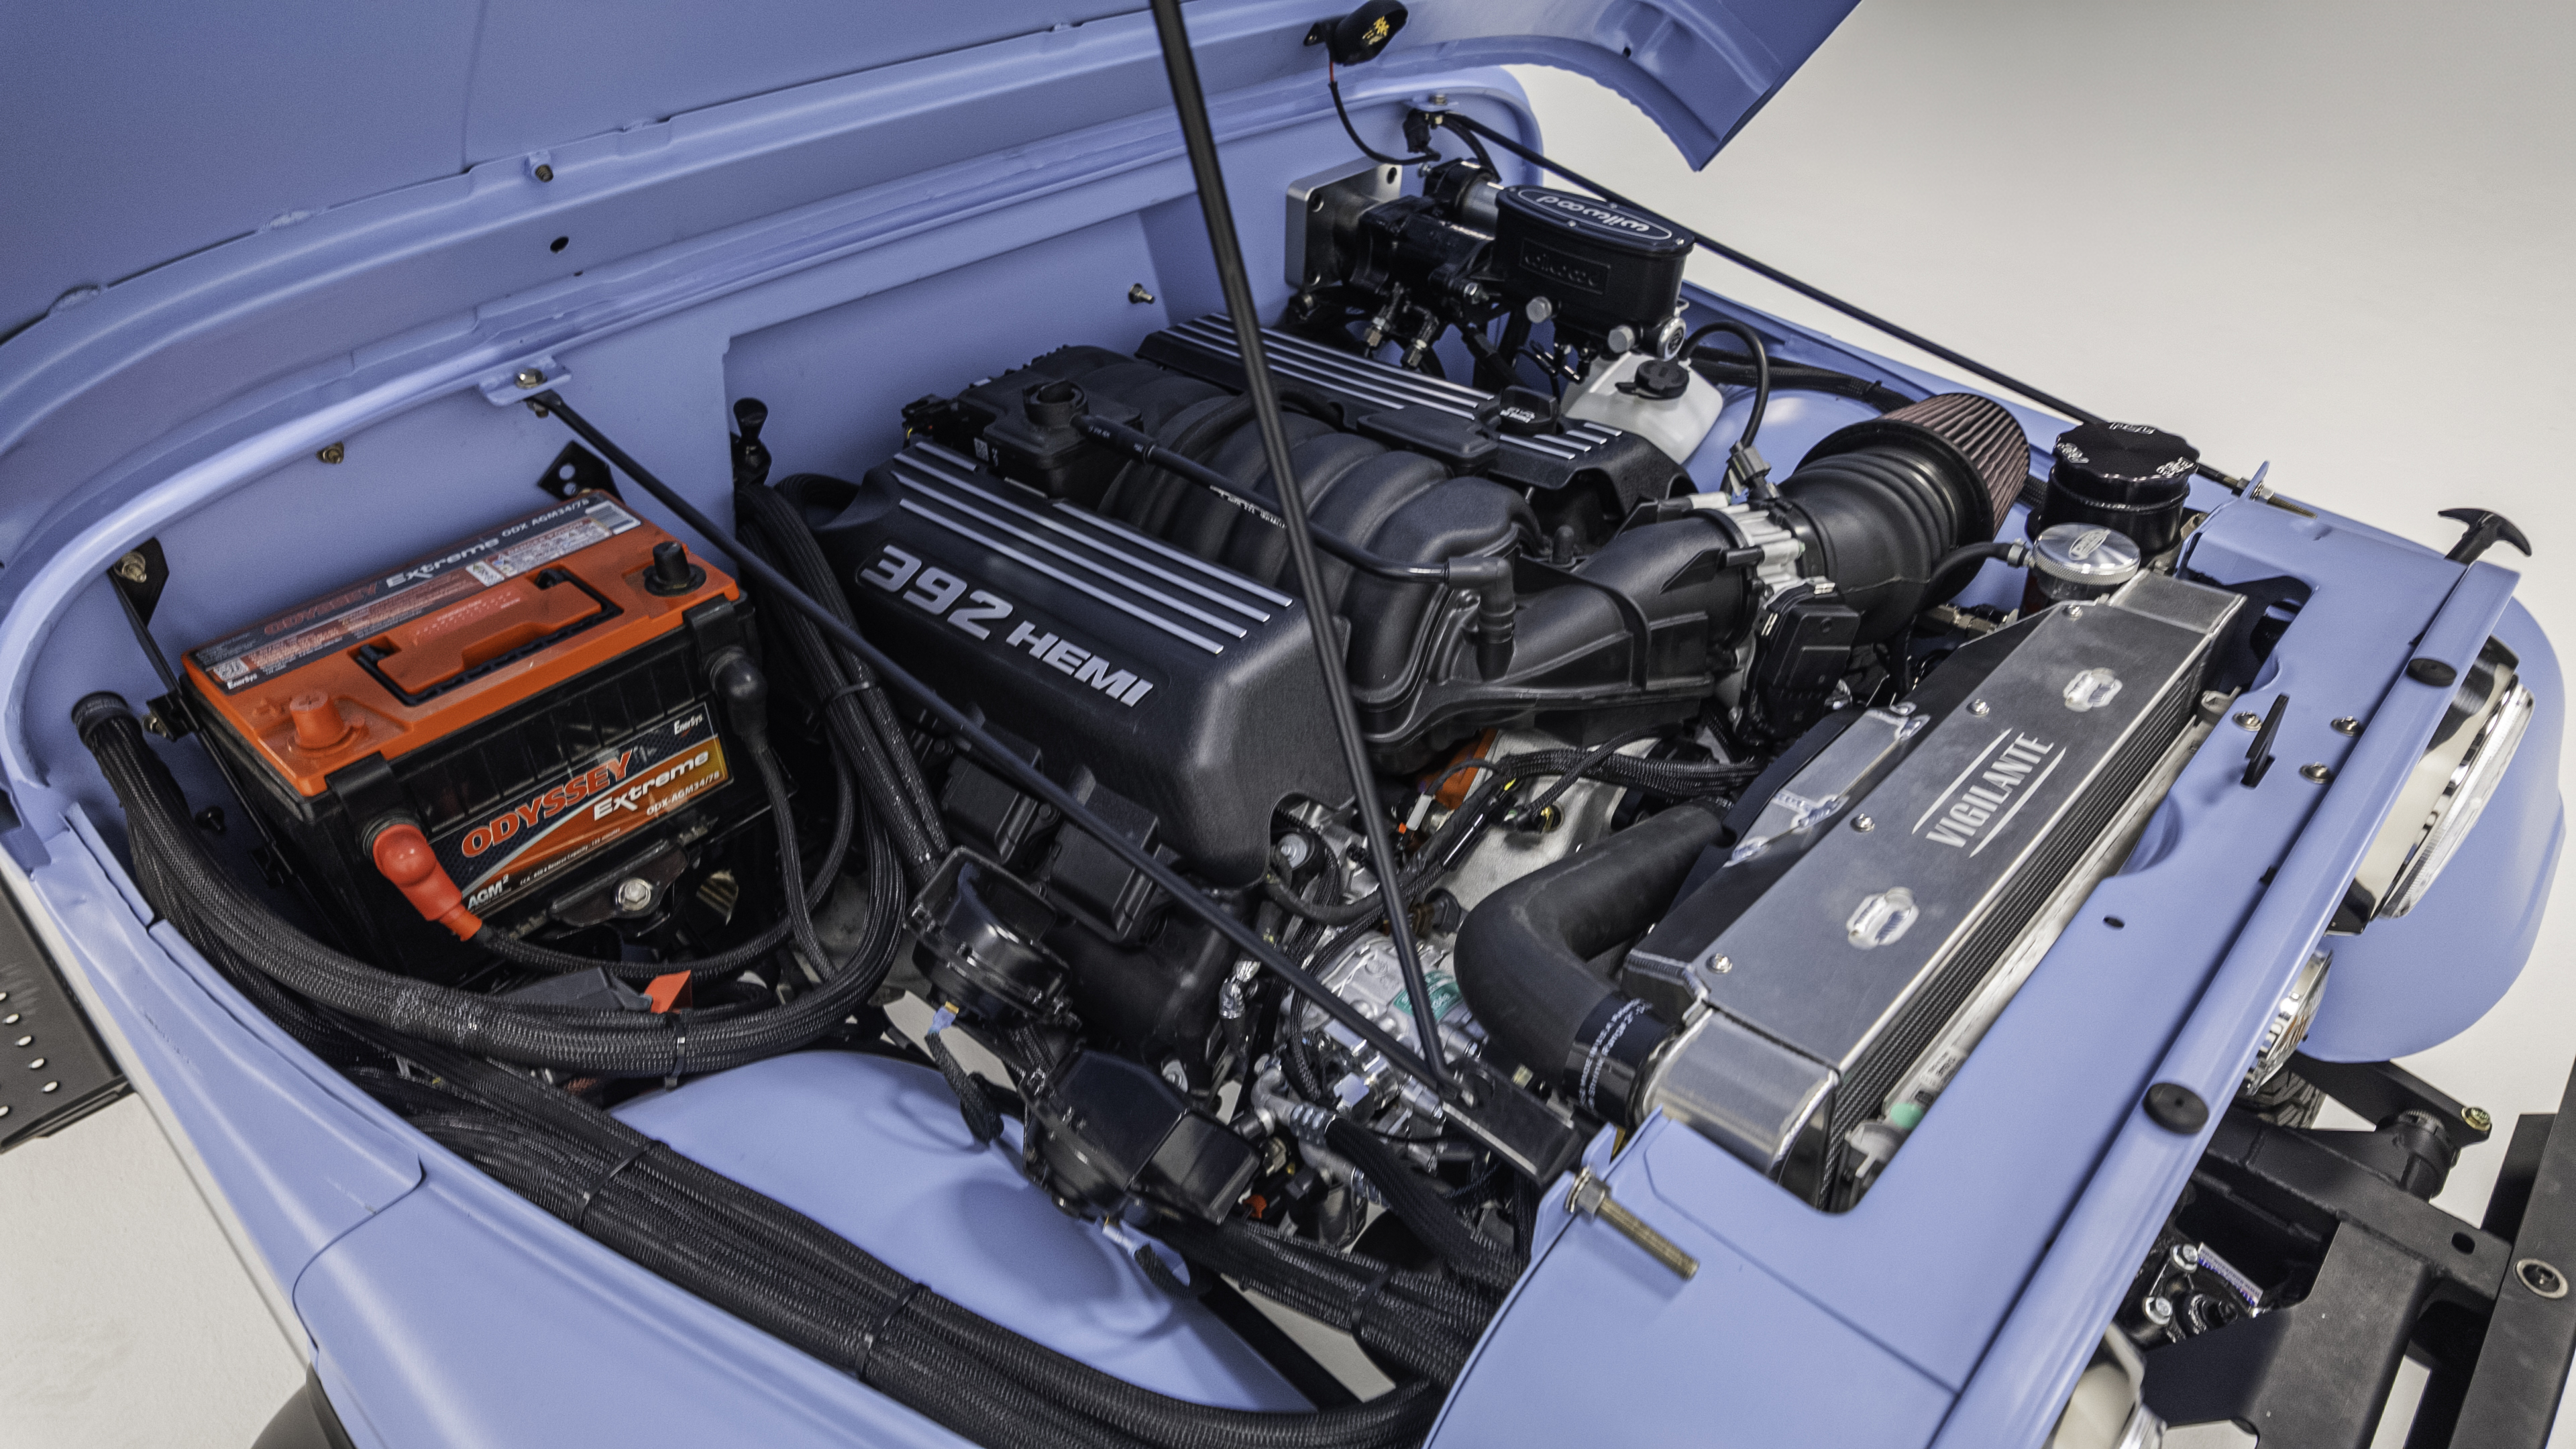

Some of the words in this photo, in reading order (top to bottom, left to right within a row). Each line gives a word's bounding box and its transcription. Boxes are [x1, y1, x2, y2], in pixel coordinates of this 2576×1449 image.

[1536, 195, 1650, 232] wilwood
[386, 538, 499, 588] Extreme
[861, 544, 1014, 641] 392
[1006, 620, 1154, 707] HEMI
[674, 713, 703, 736] EnerSys
[462, 749, 633, 858] ODYSSEY
[594, 751, 709, 822] Extreme
[1925, 731, 2054, 848] VIGILANTE
